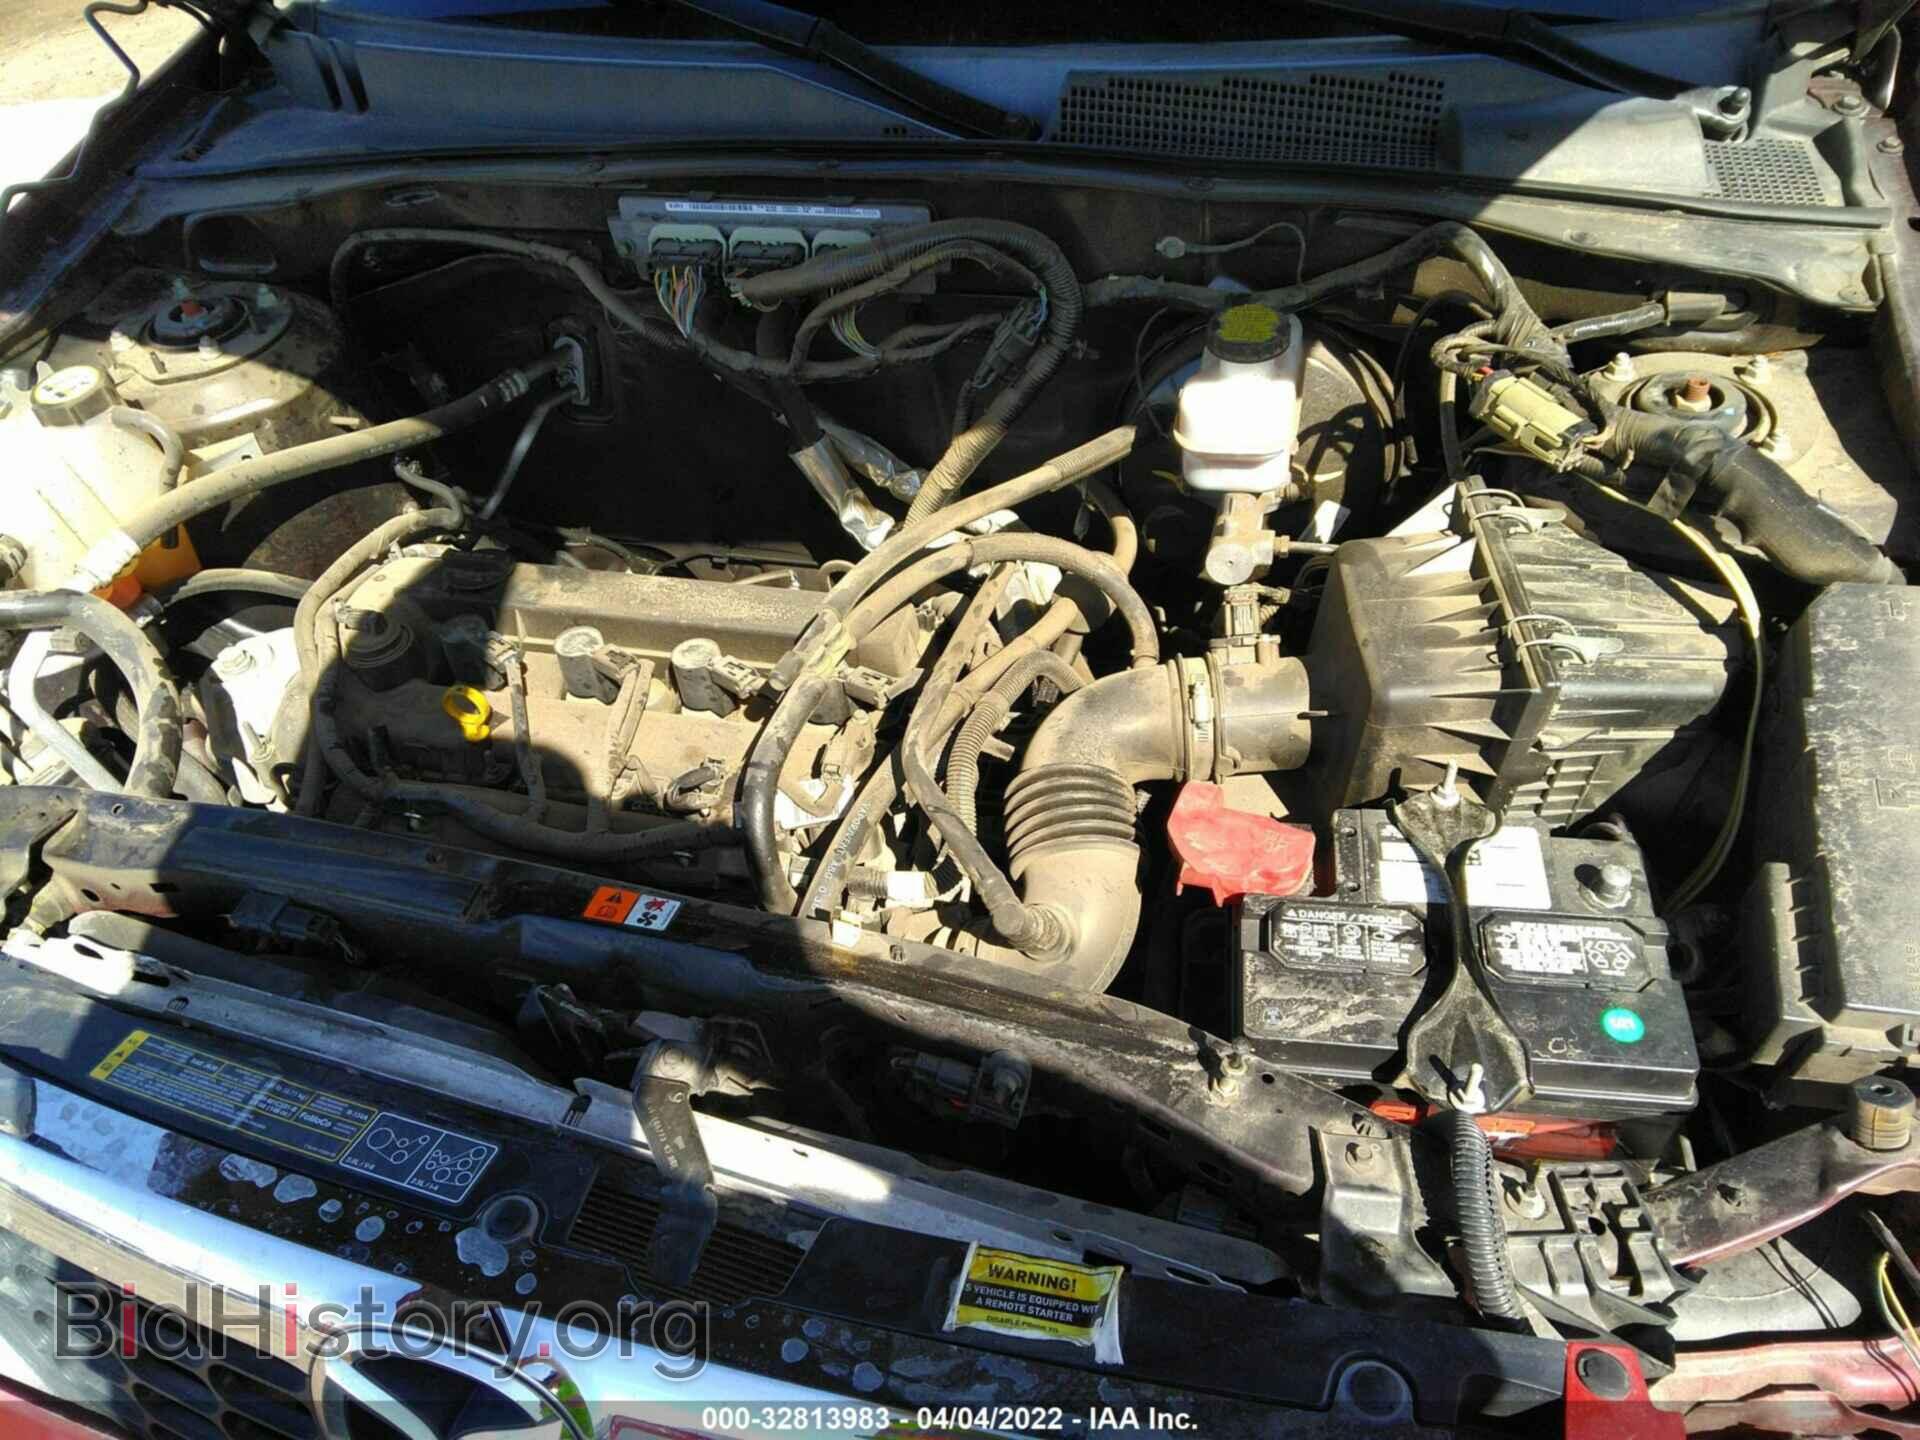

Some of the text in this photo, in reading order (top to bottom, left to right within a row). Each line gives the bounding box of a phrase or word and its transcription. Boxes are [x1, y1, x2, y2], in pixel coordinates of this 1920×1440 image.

[1298, 909, 1346, 921] DANGER
[1359, 914, 1402, 925] POISON
[987, 1263, 1077, 1293] WARNING!
[974, 1285, 1015, 1300] VEHICLE
[1016, 1292, 1028, 1302] IS
[1029, 1294, 1079, 1312] EQUIPPED
[976, 1297, 1073, 1322] A REMOTE STARTER
